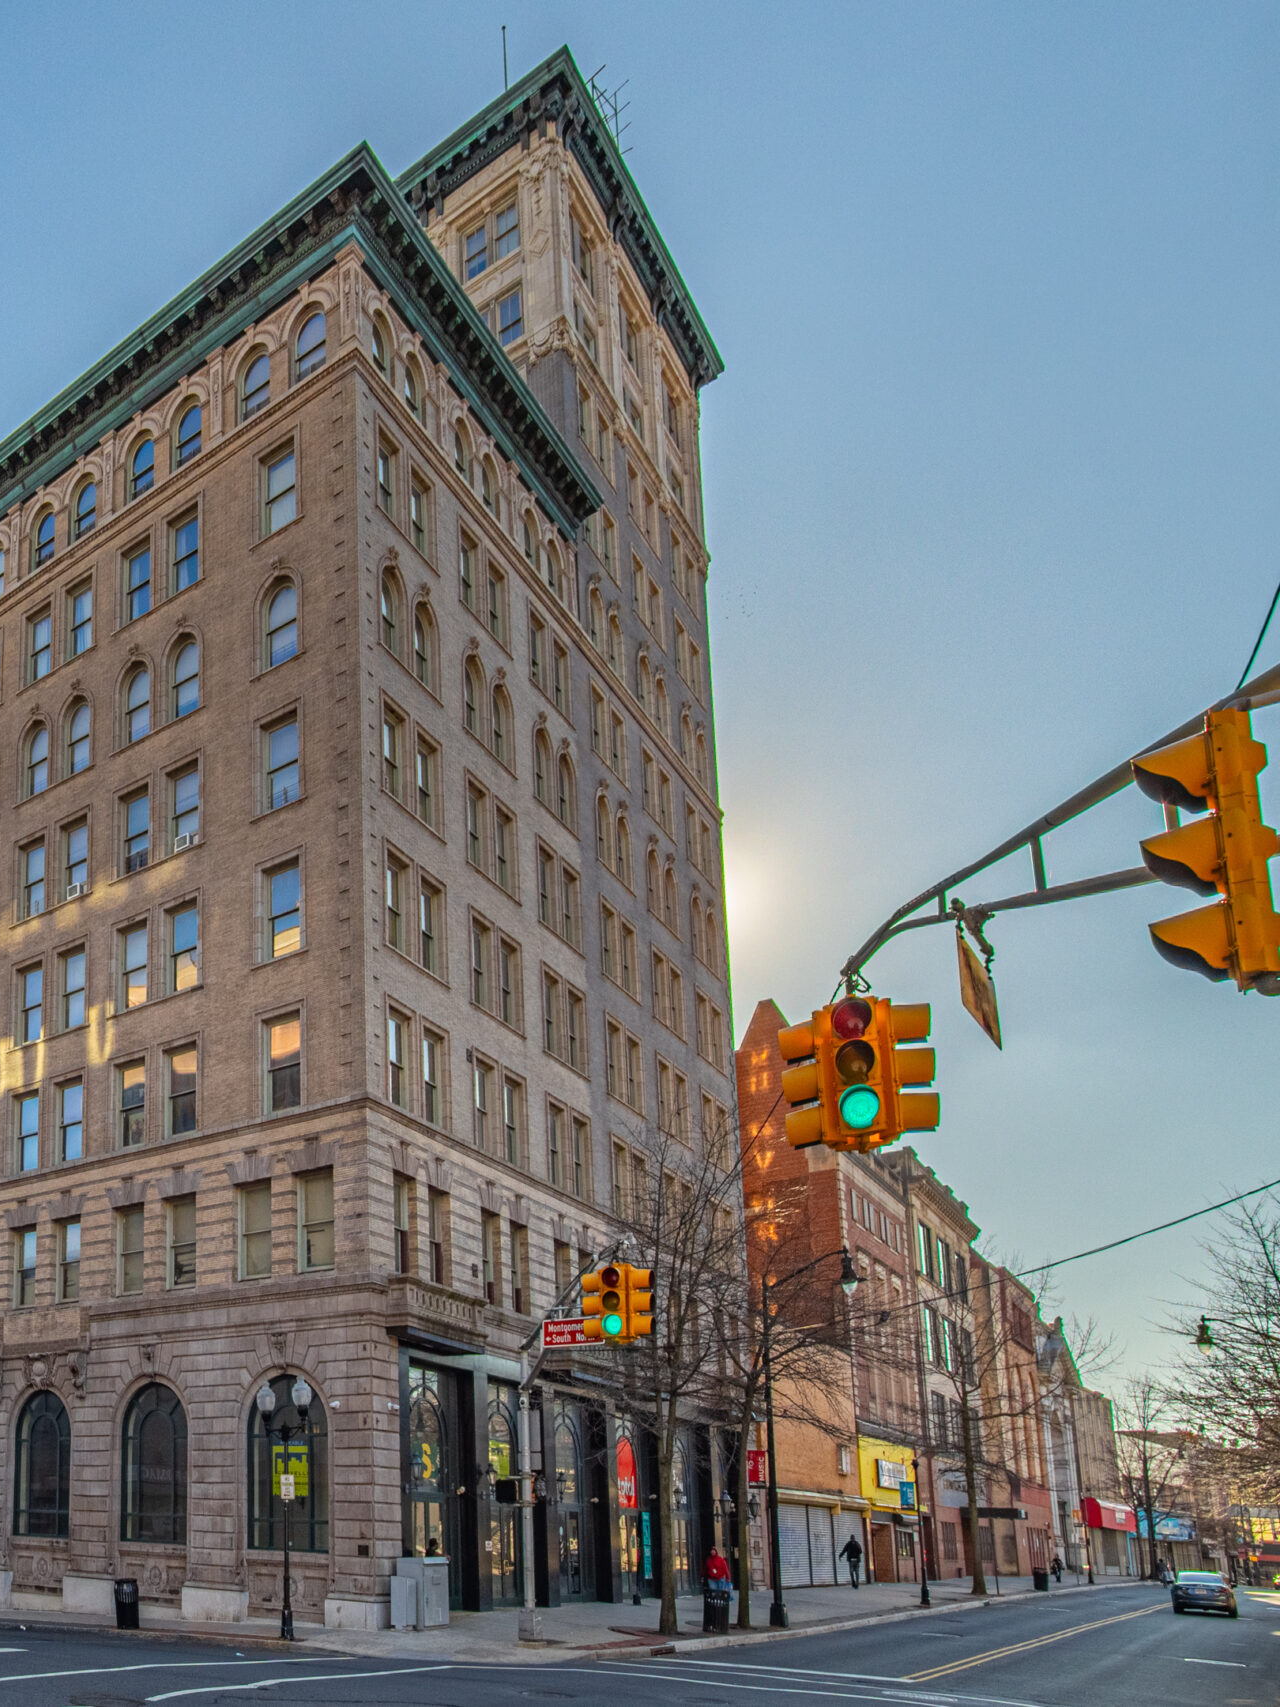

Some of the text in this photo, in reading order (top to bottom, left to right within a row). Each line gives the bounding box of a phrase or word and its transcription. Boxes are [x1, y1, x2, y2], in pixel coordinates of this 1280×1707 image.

[547, 1323, 584, 1334] Montgomer
[552, 1333, 572, 1344] South
[906, 1488, 914, 1504] ART
